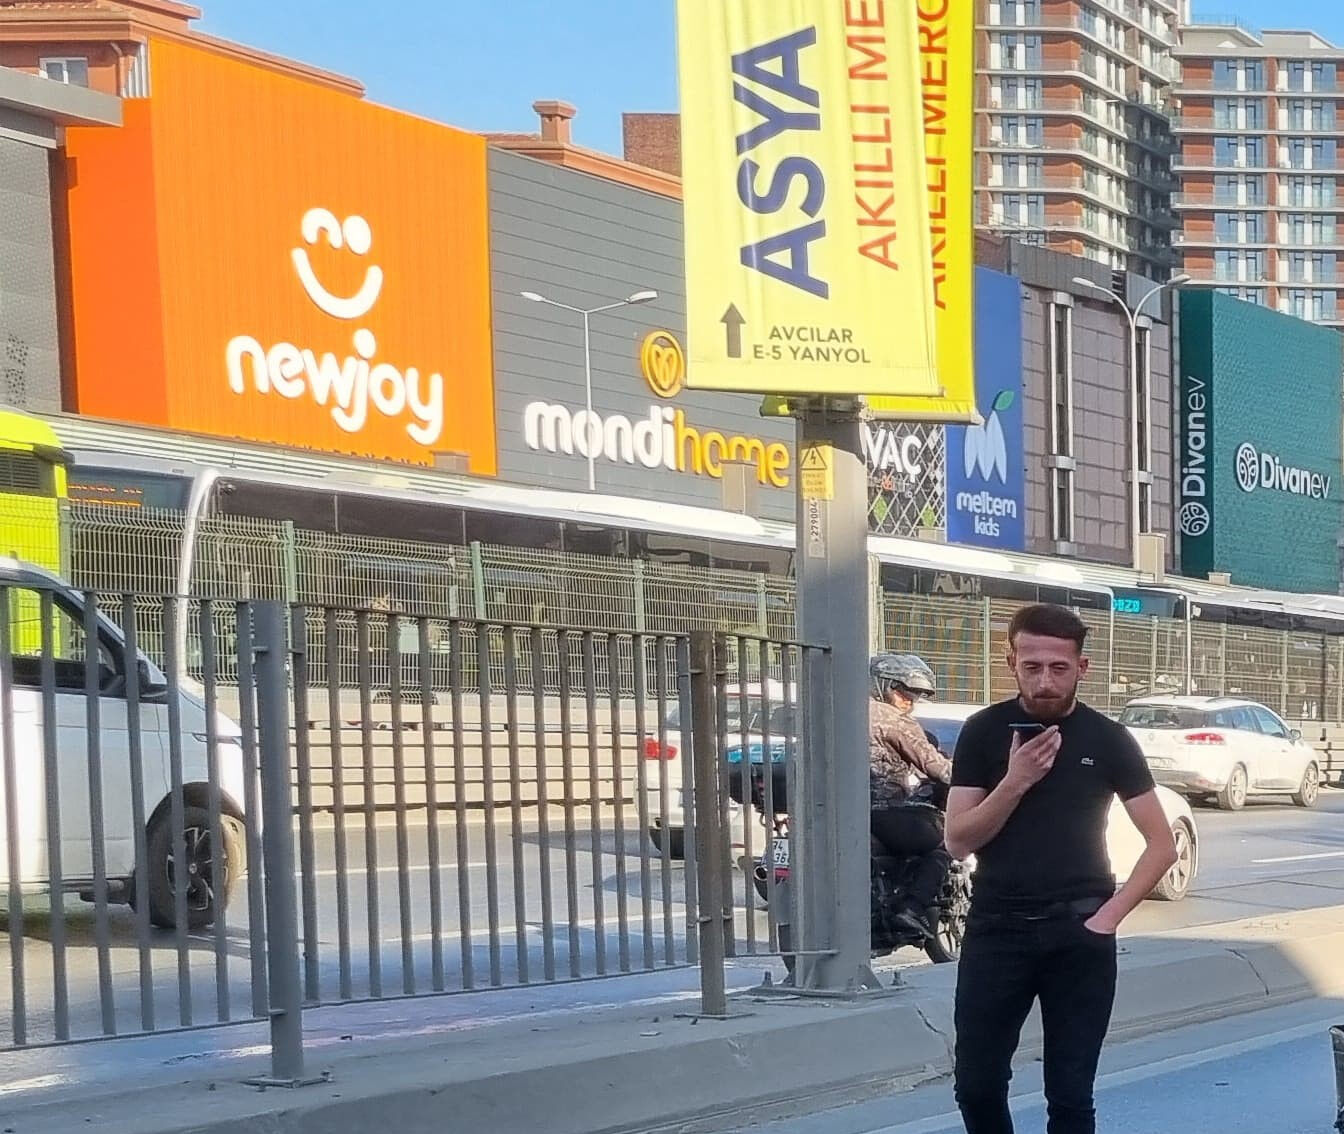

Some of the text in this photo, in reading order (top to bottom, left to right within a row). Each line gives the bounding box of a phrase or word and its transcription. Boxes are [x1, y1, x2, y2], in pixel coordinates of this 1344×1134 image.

[731, 25, 830, 300] ASYA
[850, 104, 899, 271] AKILLI
[753, 344, 871, 364] E-5 YANYOL
[768, 325, 854, 343] AVCILAR
[226, 328, 443, 446] newjoy
[1182, 375, 1206, 497] Divanev
[1260, 452, 1331, 500] Divanev
[956, 490, 1017, 519] meltem
[974, 515, 1000, 537] kids
